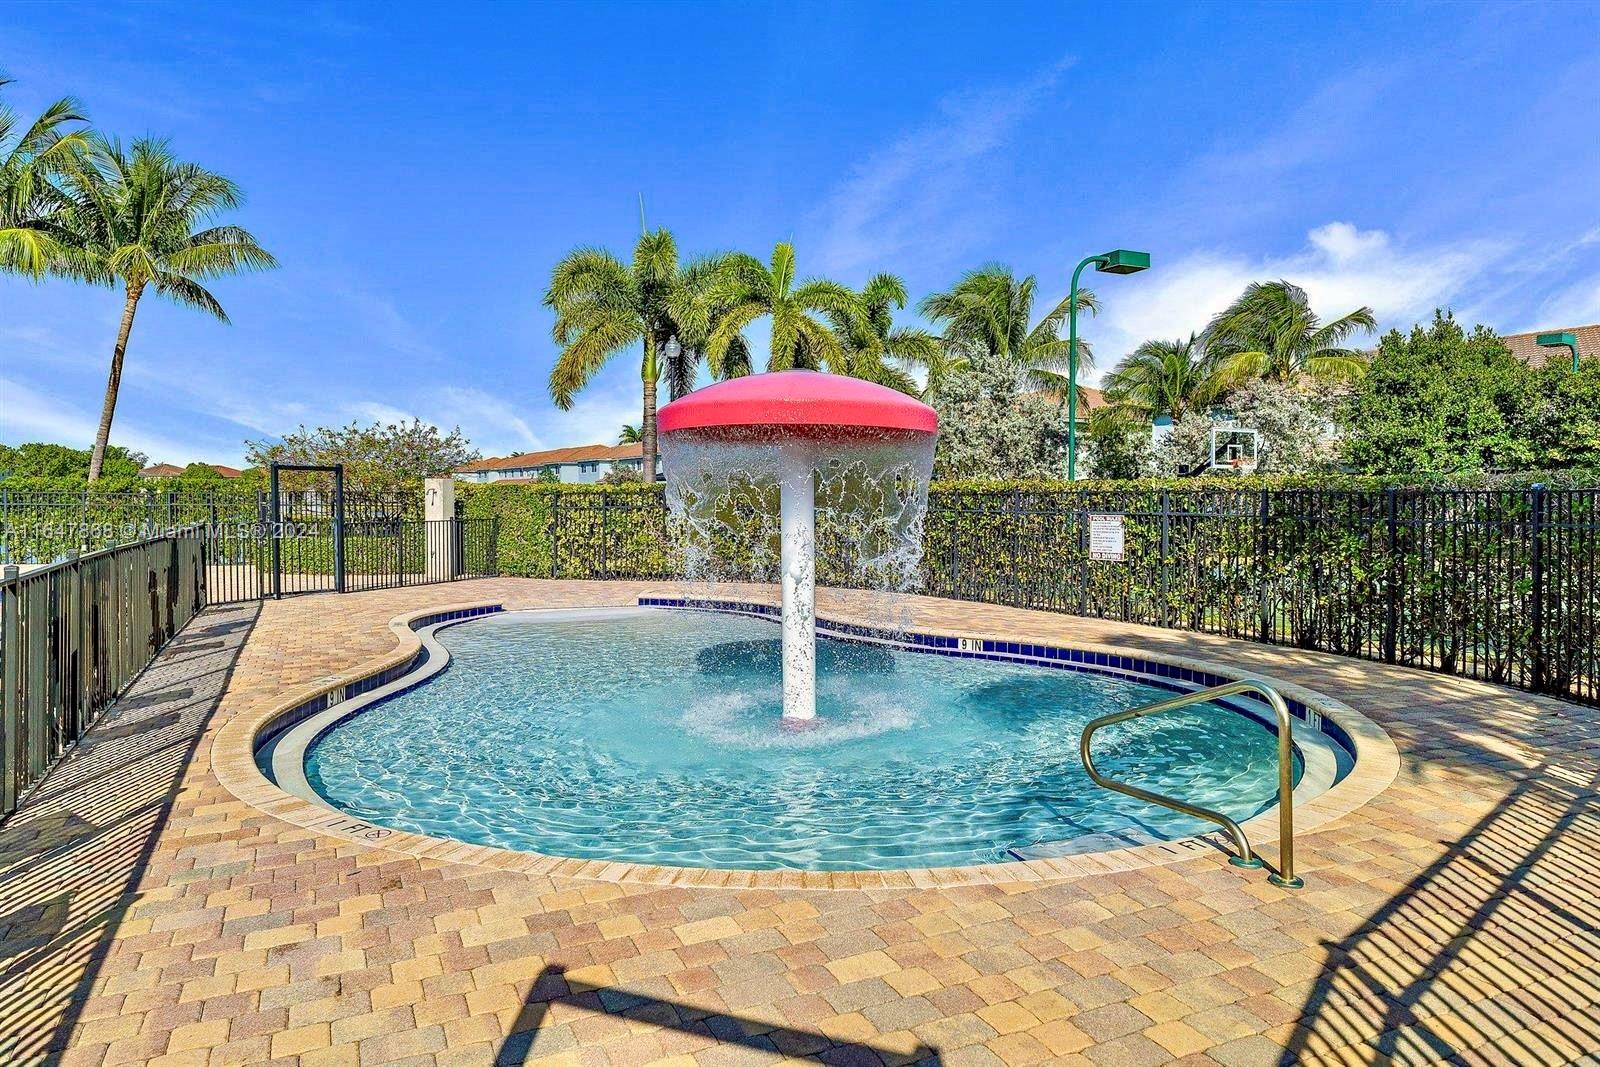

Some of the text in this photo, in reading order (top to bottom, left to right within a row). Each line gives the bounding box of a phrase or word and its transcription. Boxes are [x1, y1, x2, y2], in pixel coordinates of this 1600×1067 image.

[962, 639, 982, 652] 9 IN
[336, 687, 346, 704] IN
[340, 823, 372, 834] FT
[1177, 839, 1208, 851] FT
